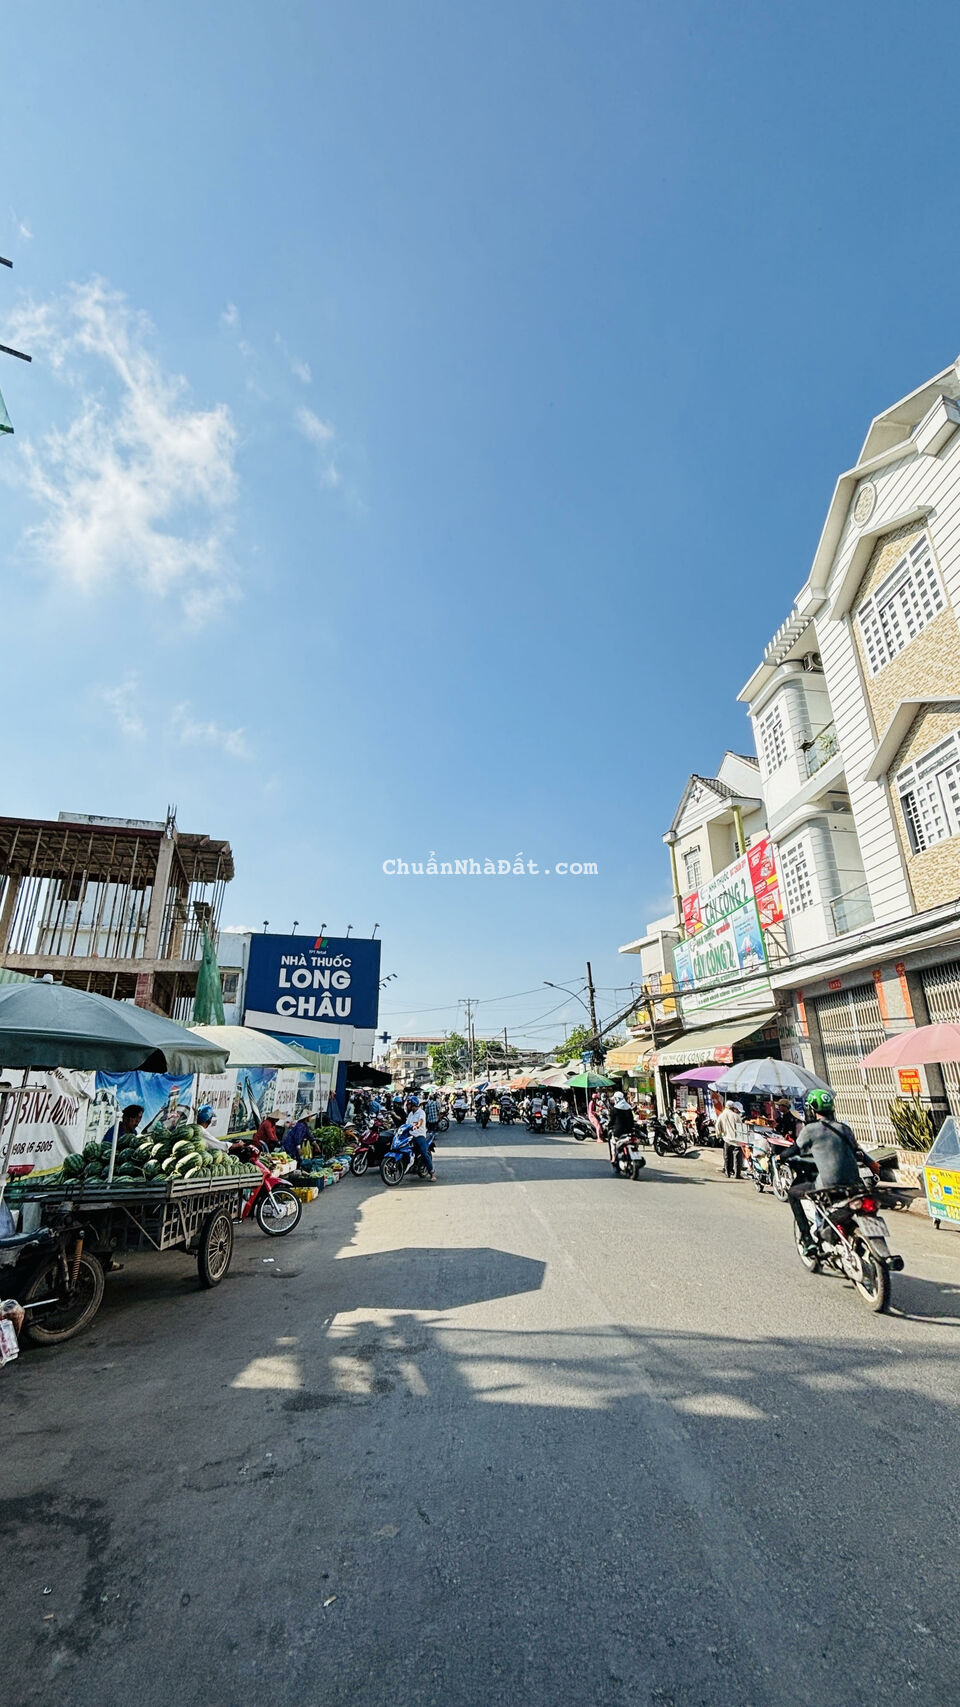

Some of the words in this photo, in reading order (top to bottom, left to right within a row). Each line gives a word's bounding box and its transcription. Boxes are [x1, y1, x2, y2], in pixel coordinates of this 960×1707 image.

[741, 877, 749, 902] 2
[281, 953, 307, 966] NHÀ
[311, 953, 352, 968] THUỐC
[726, 940, 736, 969] 2
[278, 968, 352, 990] LONG
[275, 991, 352, 1017] CHÂU
[35, 1140, 54, 1152] 5005
